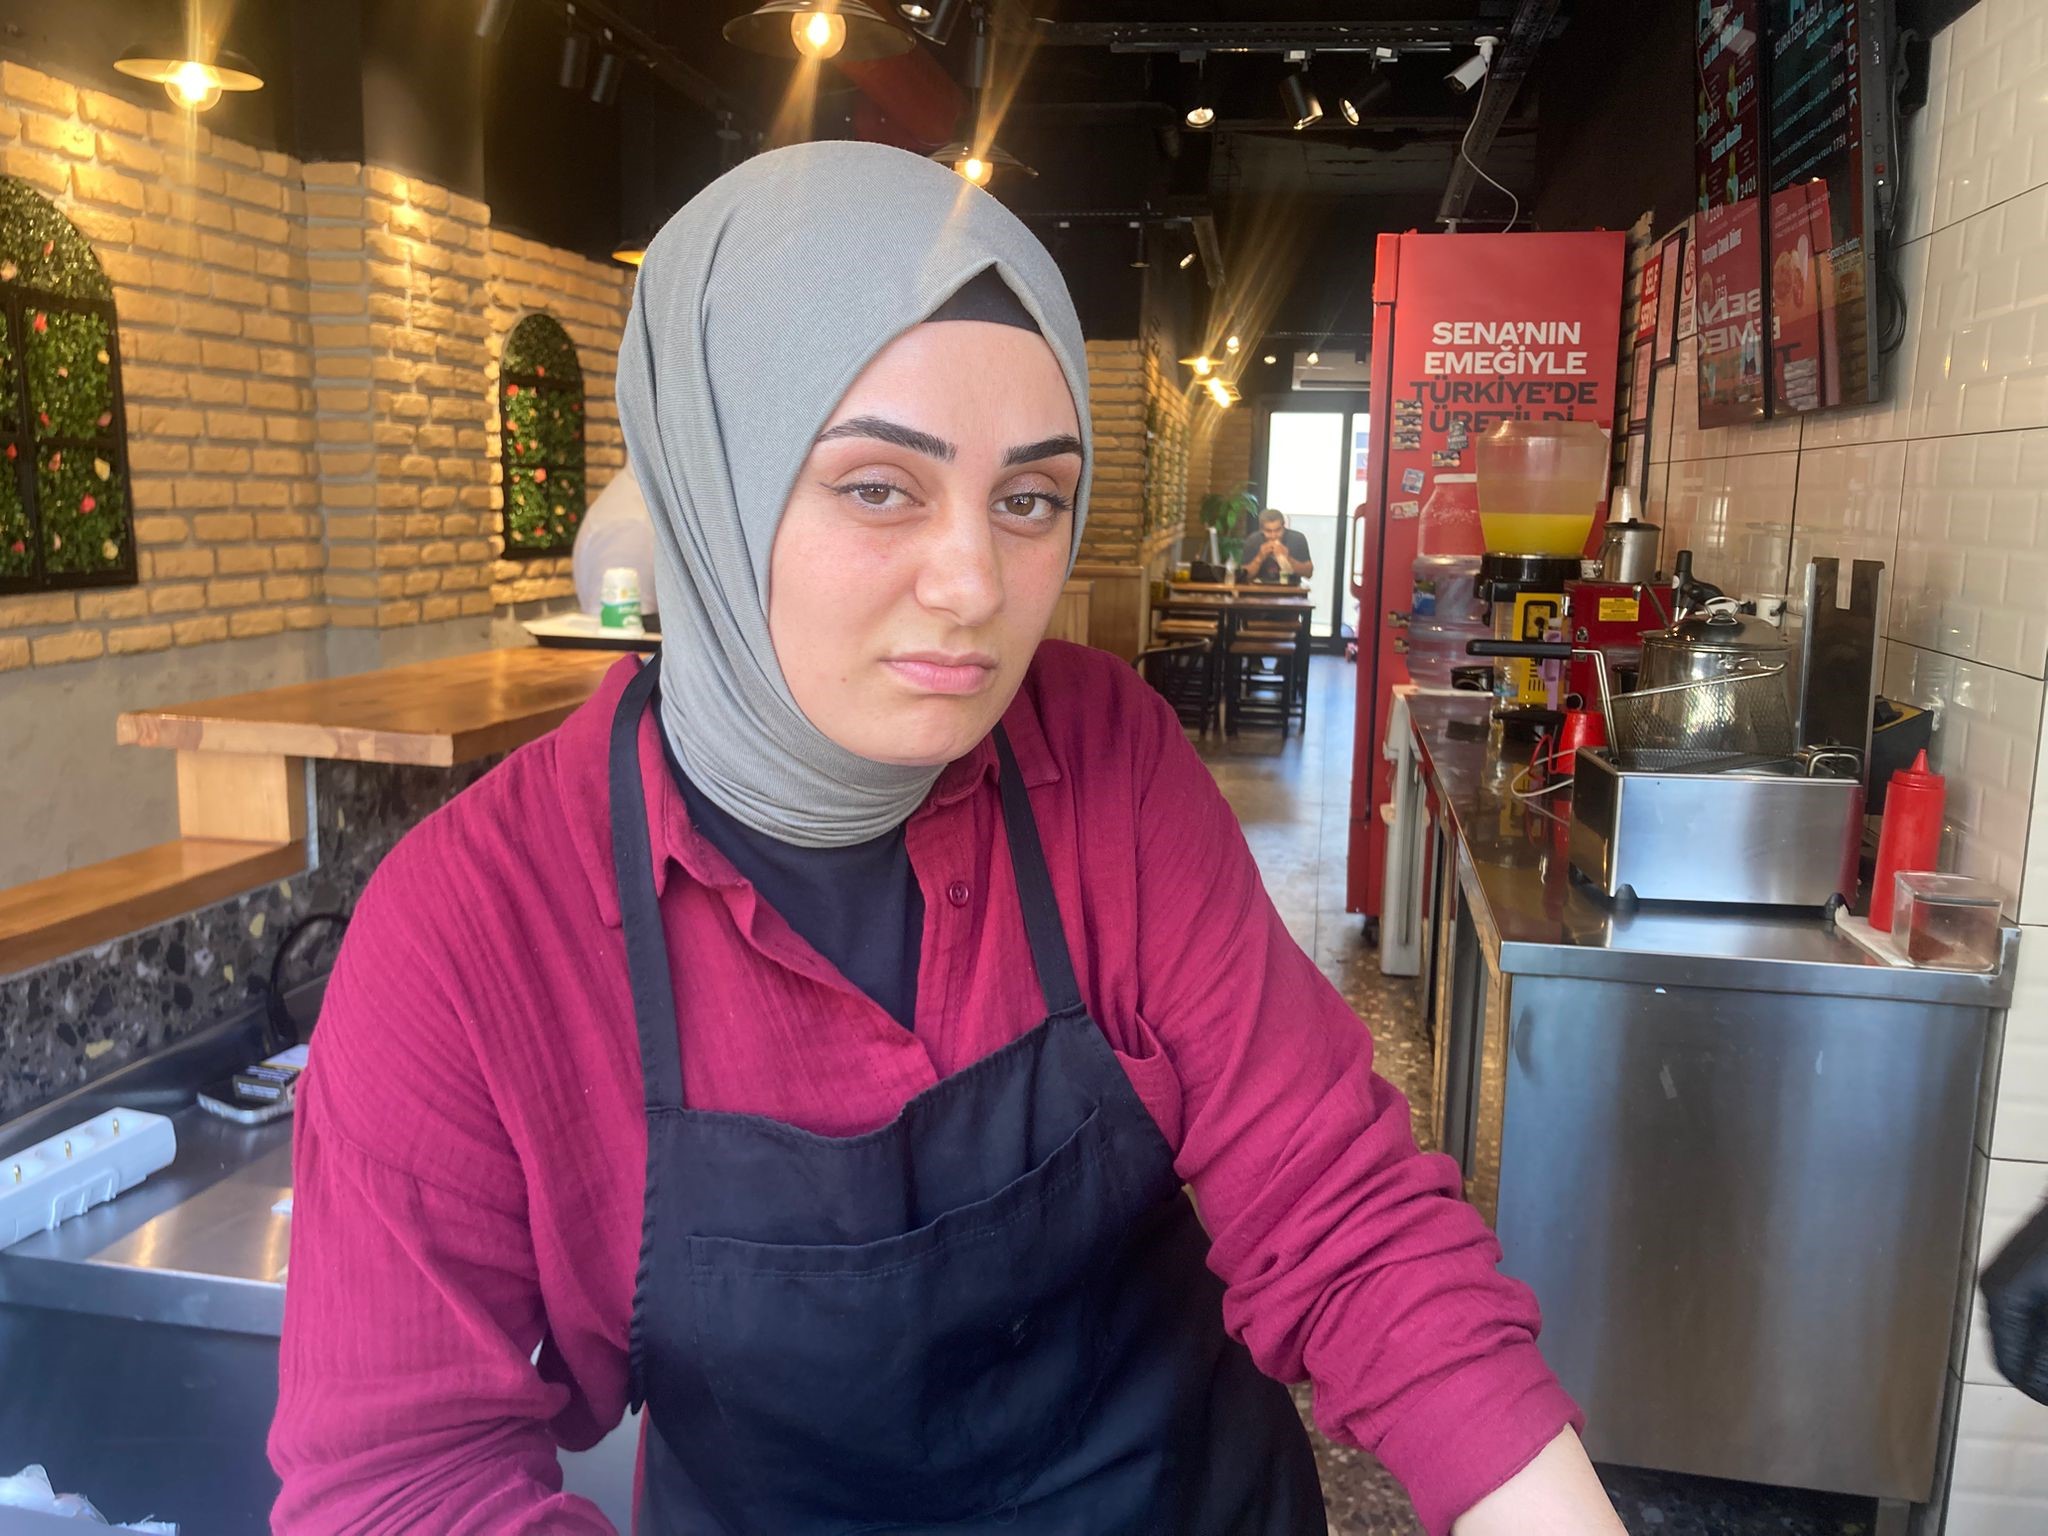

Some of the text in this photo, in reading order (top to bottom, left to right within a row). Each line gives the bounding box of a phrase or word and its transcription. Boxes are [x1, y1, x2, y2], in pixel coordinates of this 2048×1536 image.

[1432, 321, 1581, 345] SENA'NIN
[1424, 345, 1588, 375] EMEĞİYLE
[1409, 375, 1599, 405] TÜRKİYE'DE
